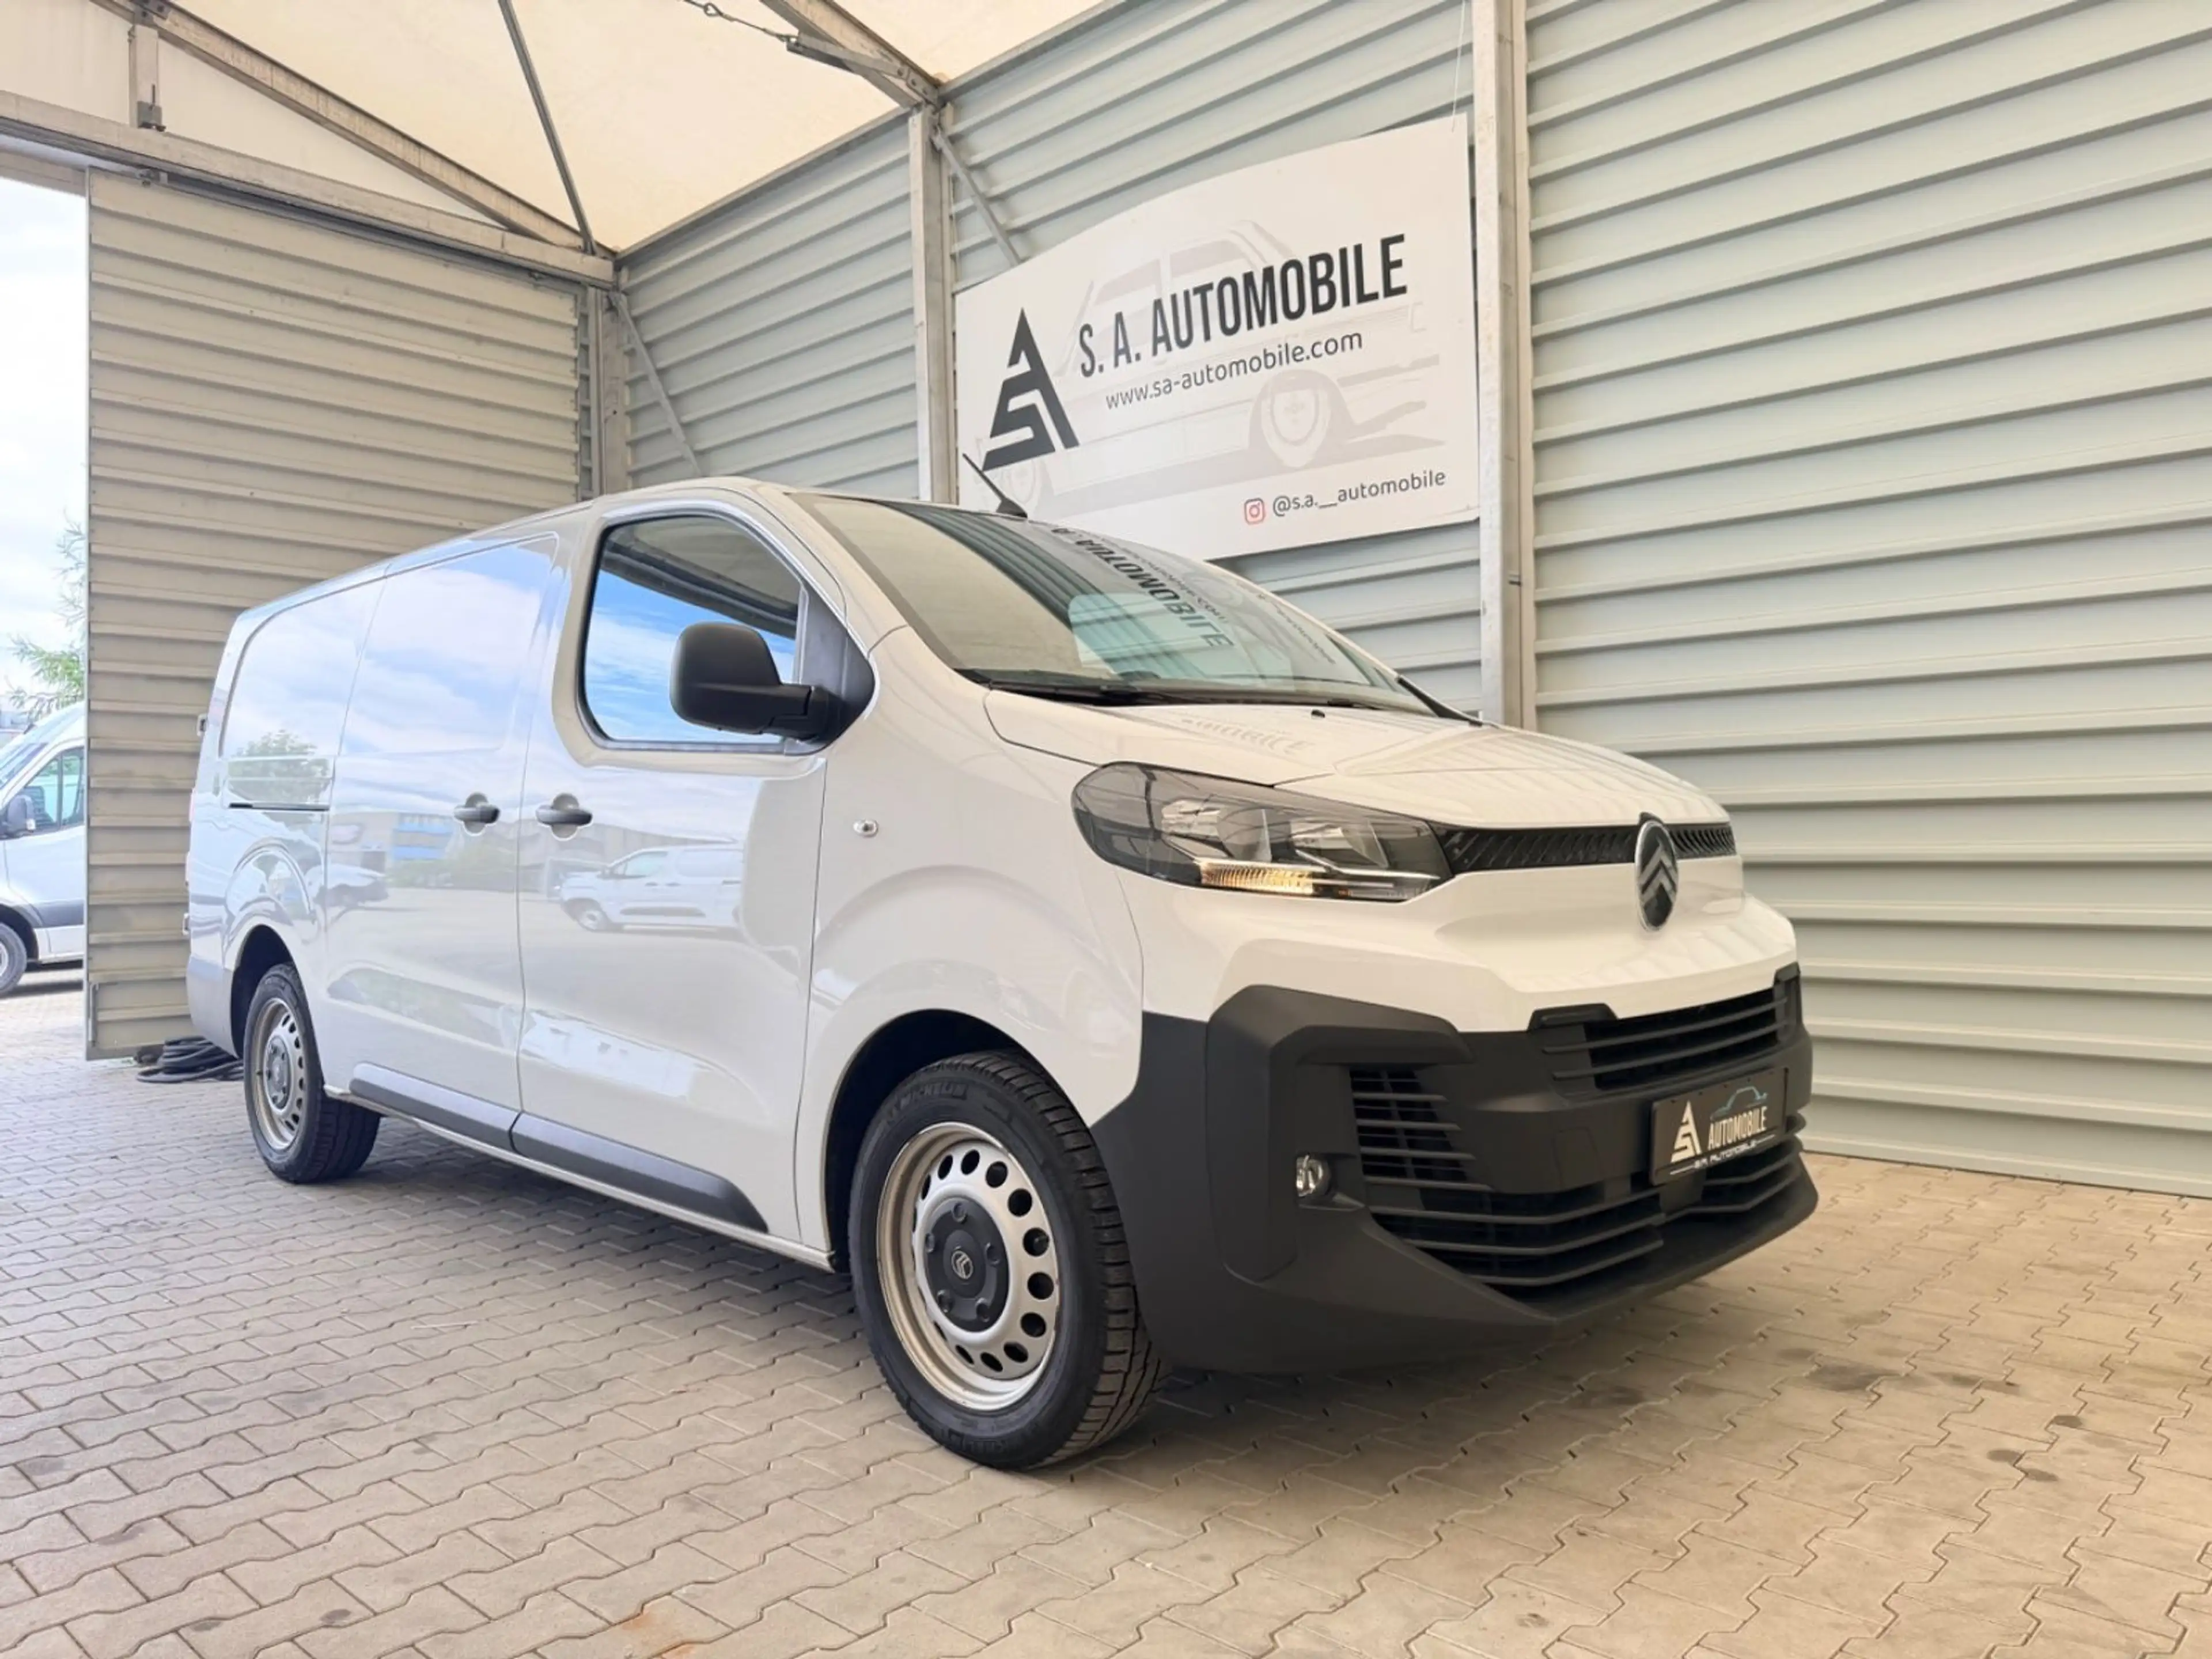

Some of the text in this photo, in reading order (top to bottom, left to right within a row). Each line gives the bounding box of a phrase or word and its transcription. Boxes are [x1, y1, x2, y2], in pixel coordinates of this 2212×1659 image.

[1078, 233, 1408, 378] S. A. AUTOMOBILE
[1105, 332, 1363, 410] www.sa-automobile.com
[1707, 1106, 1768, 1152] AUTOMOBILE
